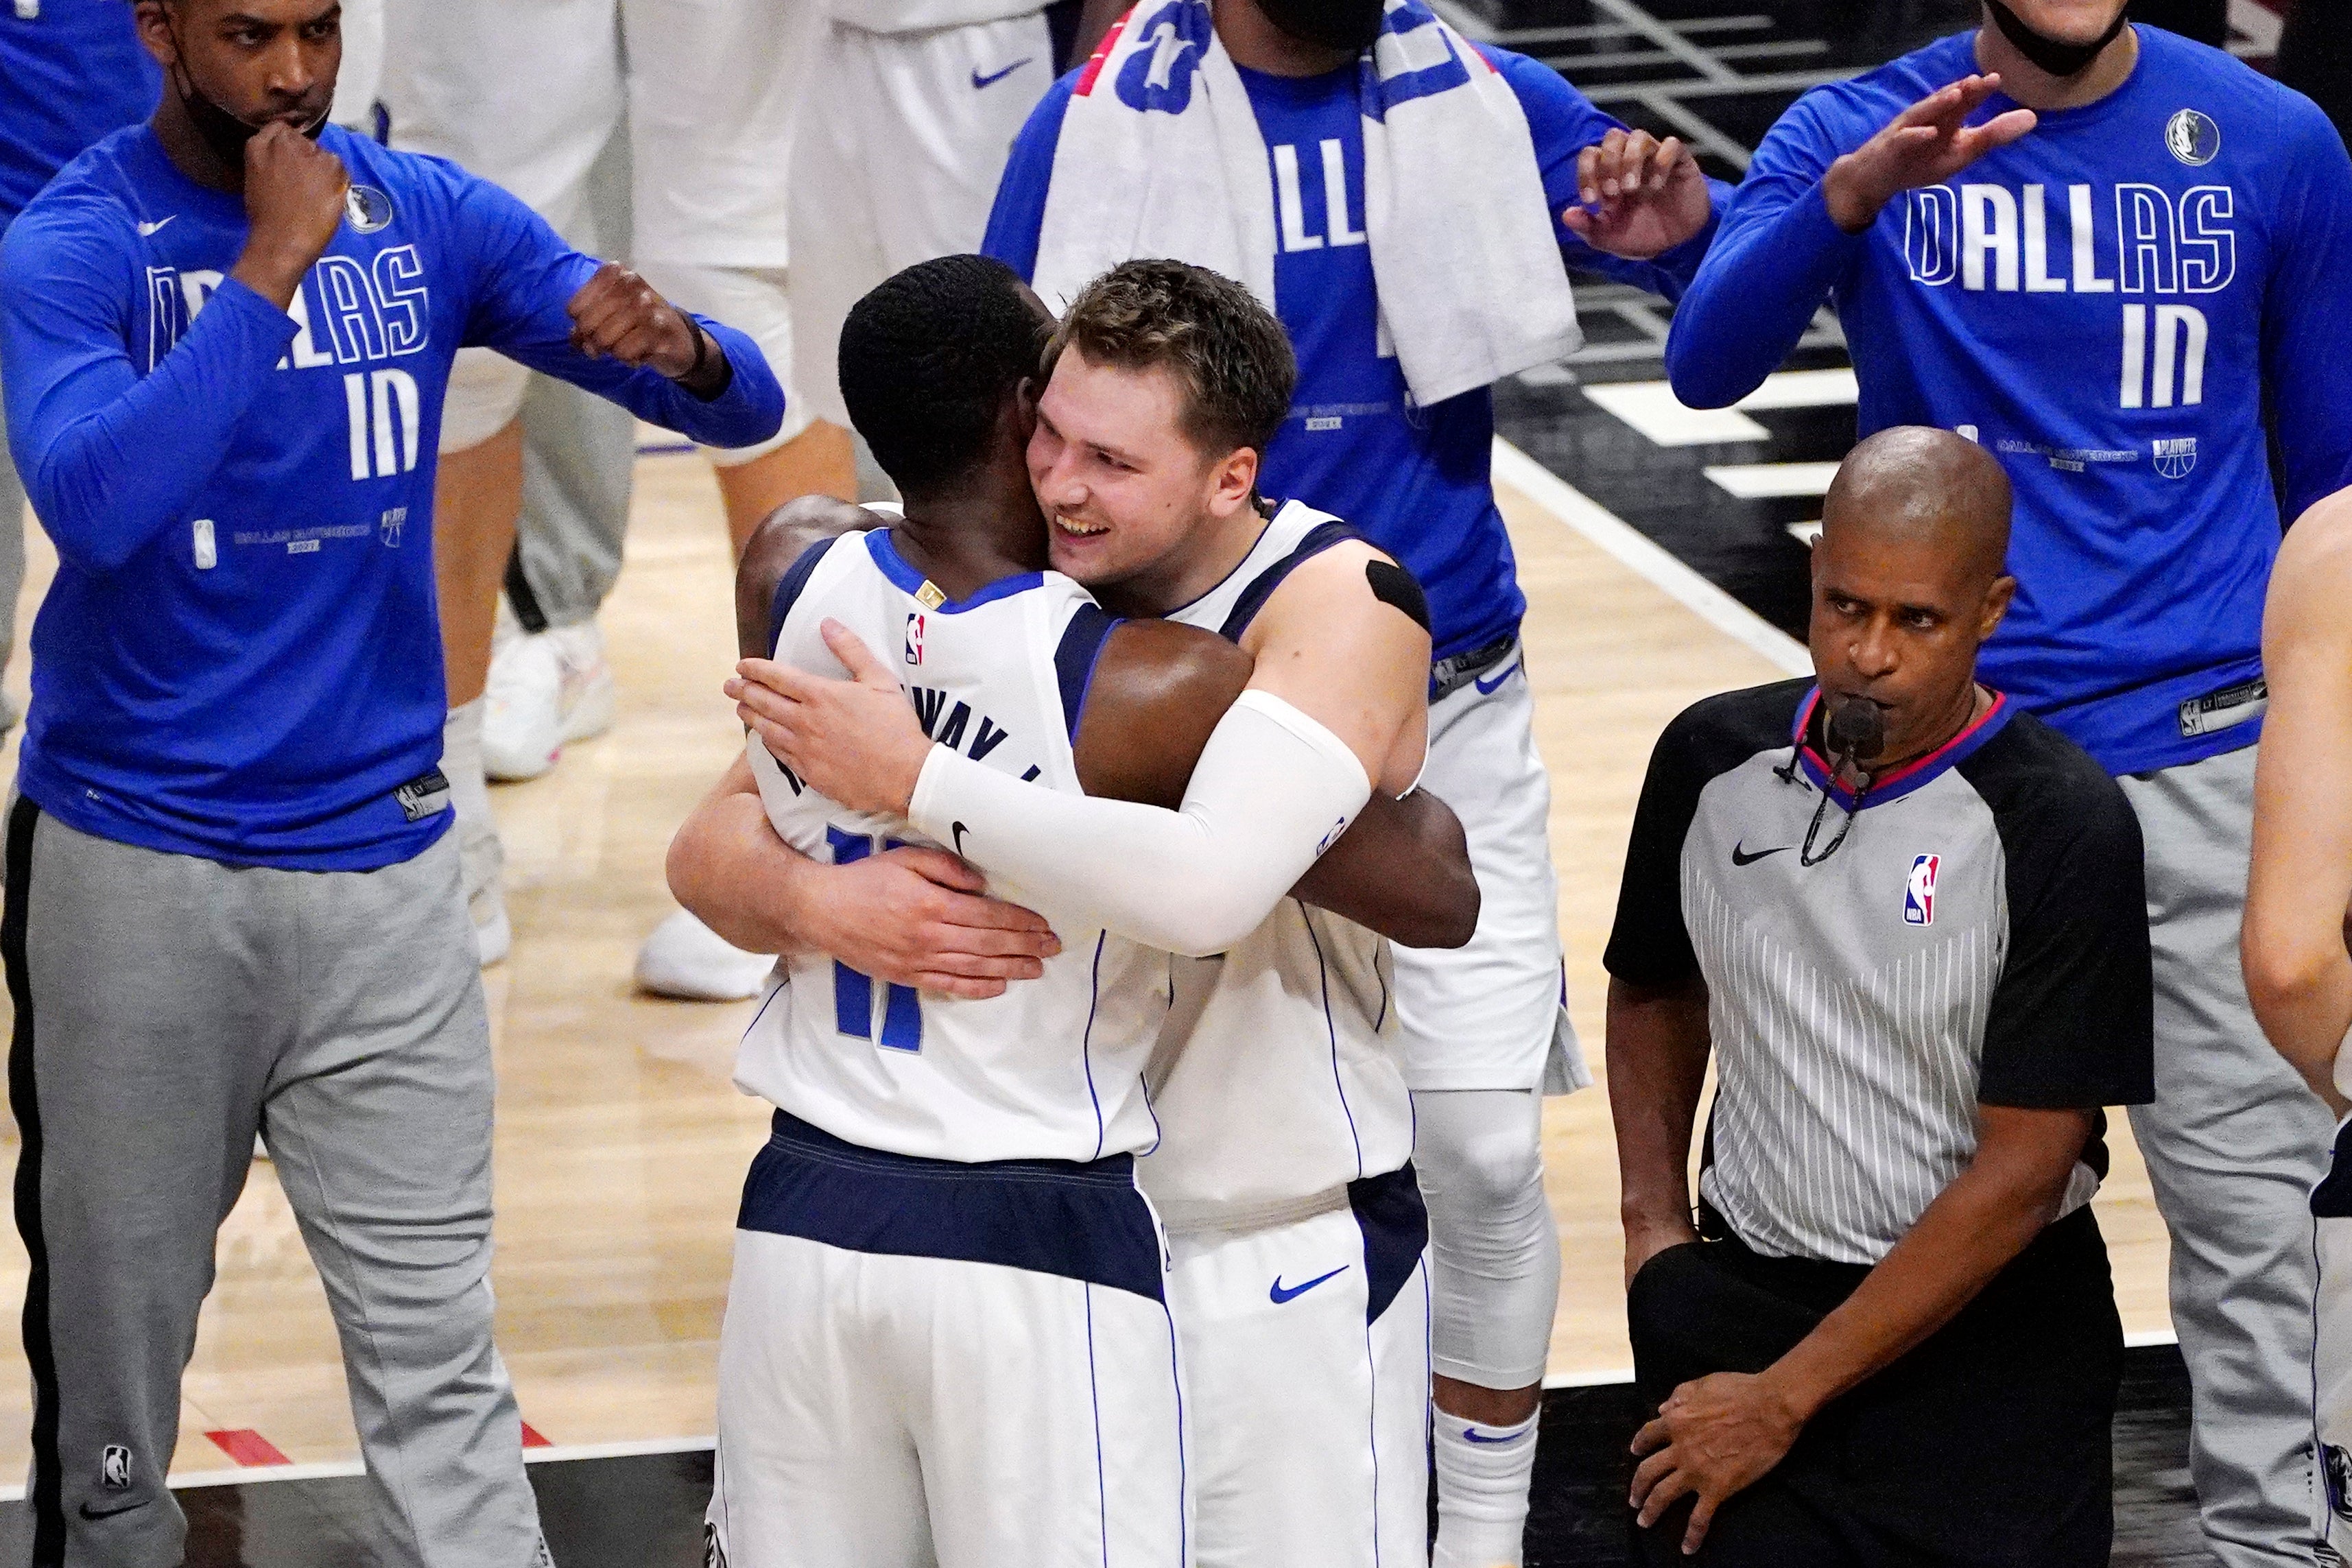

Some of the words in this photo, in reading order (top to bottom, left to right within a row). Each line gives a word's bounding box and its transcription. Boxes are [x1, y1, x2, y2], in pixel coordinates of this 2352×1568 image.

[1905, 182, 2235, 294] DALLAS
[2119, 303, 2209, 408] IN
[344, 368, 420, 481] IN
[1906, 907, 1921, 921] NBA
